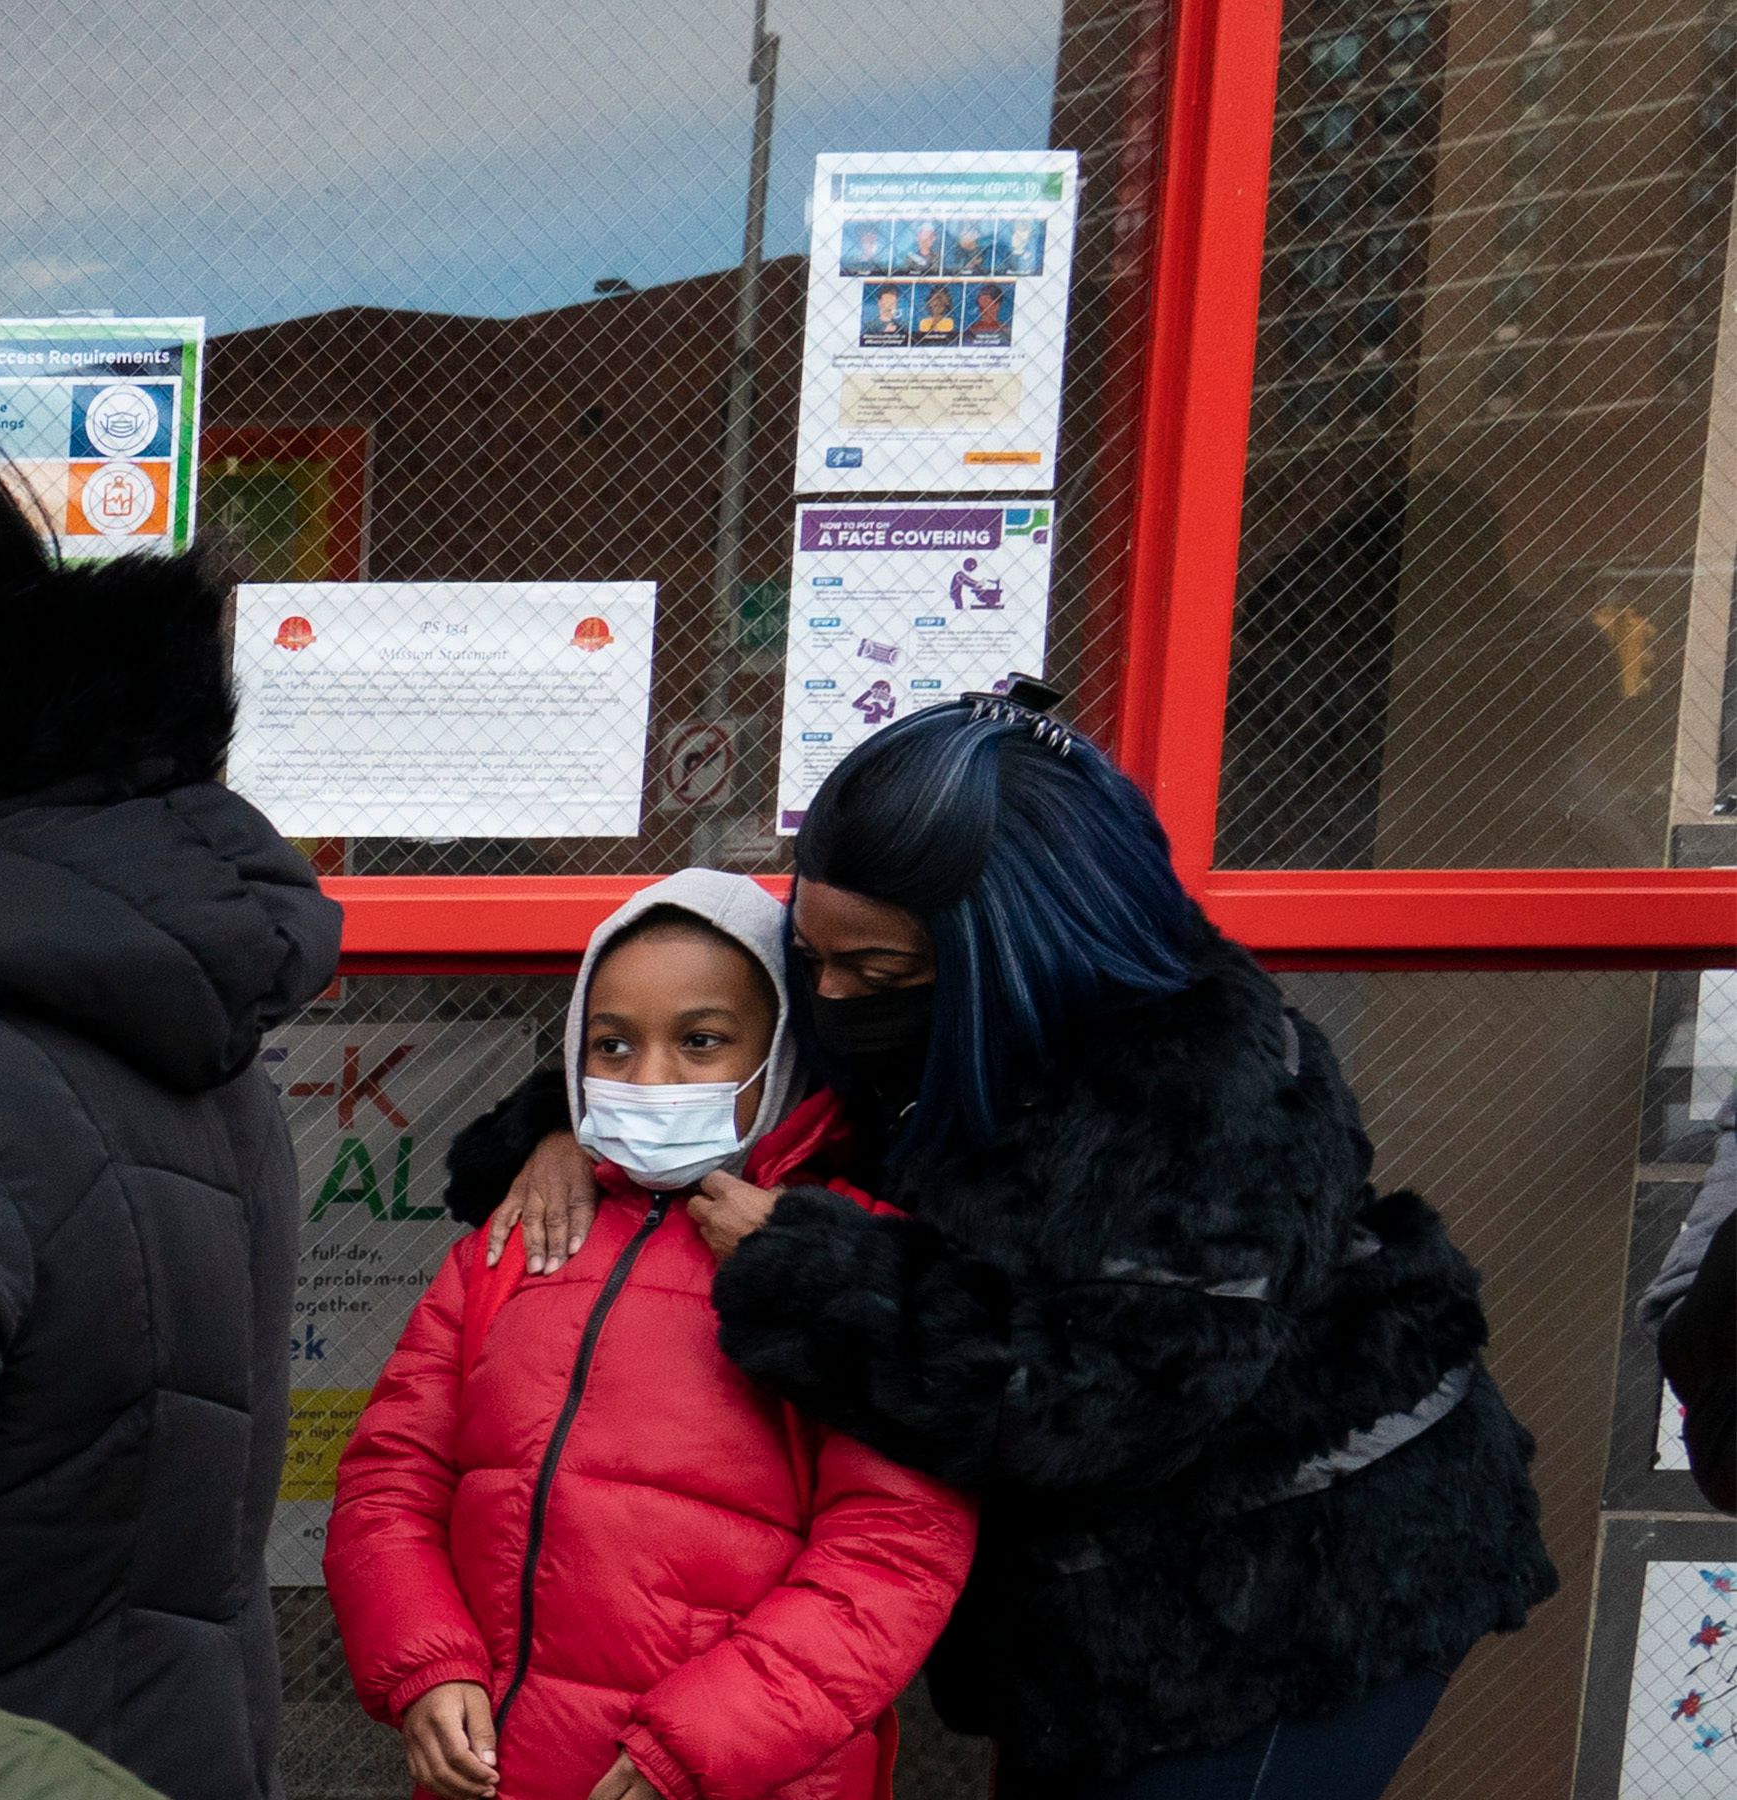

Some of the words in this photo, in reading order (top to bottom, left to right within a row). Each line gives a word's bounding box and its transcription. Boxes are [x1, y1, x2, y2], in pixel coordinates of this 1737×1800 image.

[49, 349, 170, 367] Requirements
[819, 522, 842, 530] HOW
[843, 522, 855, 530] TO
[856, 522, 875, 530] PUT
[818, 531, 833, 546] A
[838, 531, 886, 546] FACE
[890, 530, 991, 546] COVERING
[379, 647, 433, 661] Mission
[439, 647, 508, 661] Statement
[261, 1045, 415, 1130] -K
[307, 1136, 445, 1222] AL
[297, 1276, 308, 1287] o
[313, 1269, 434, 1289] problem-solv
[295, 1297, 373, 1317] ogether.
